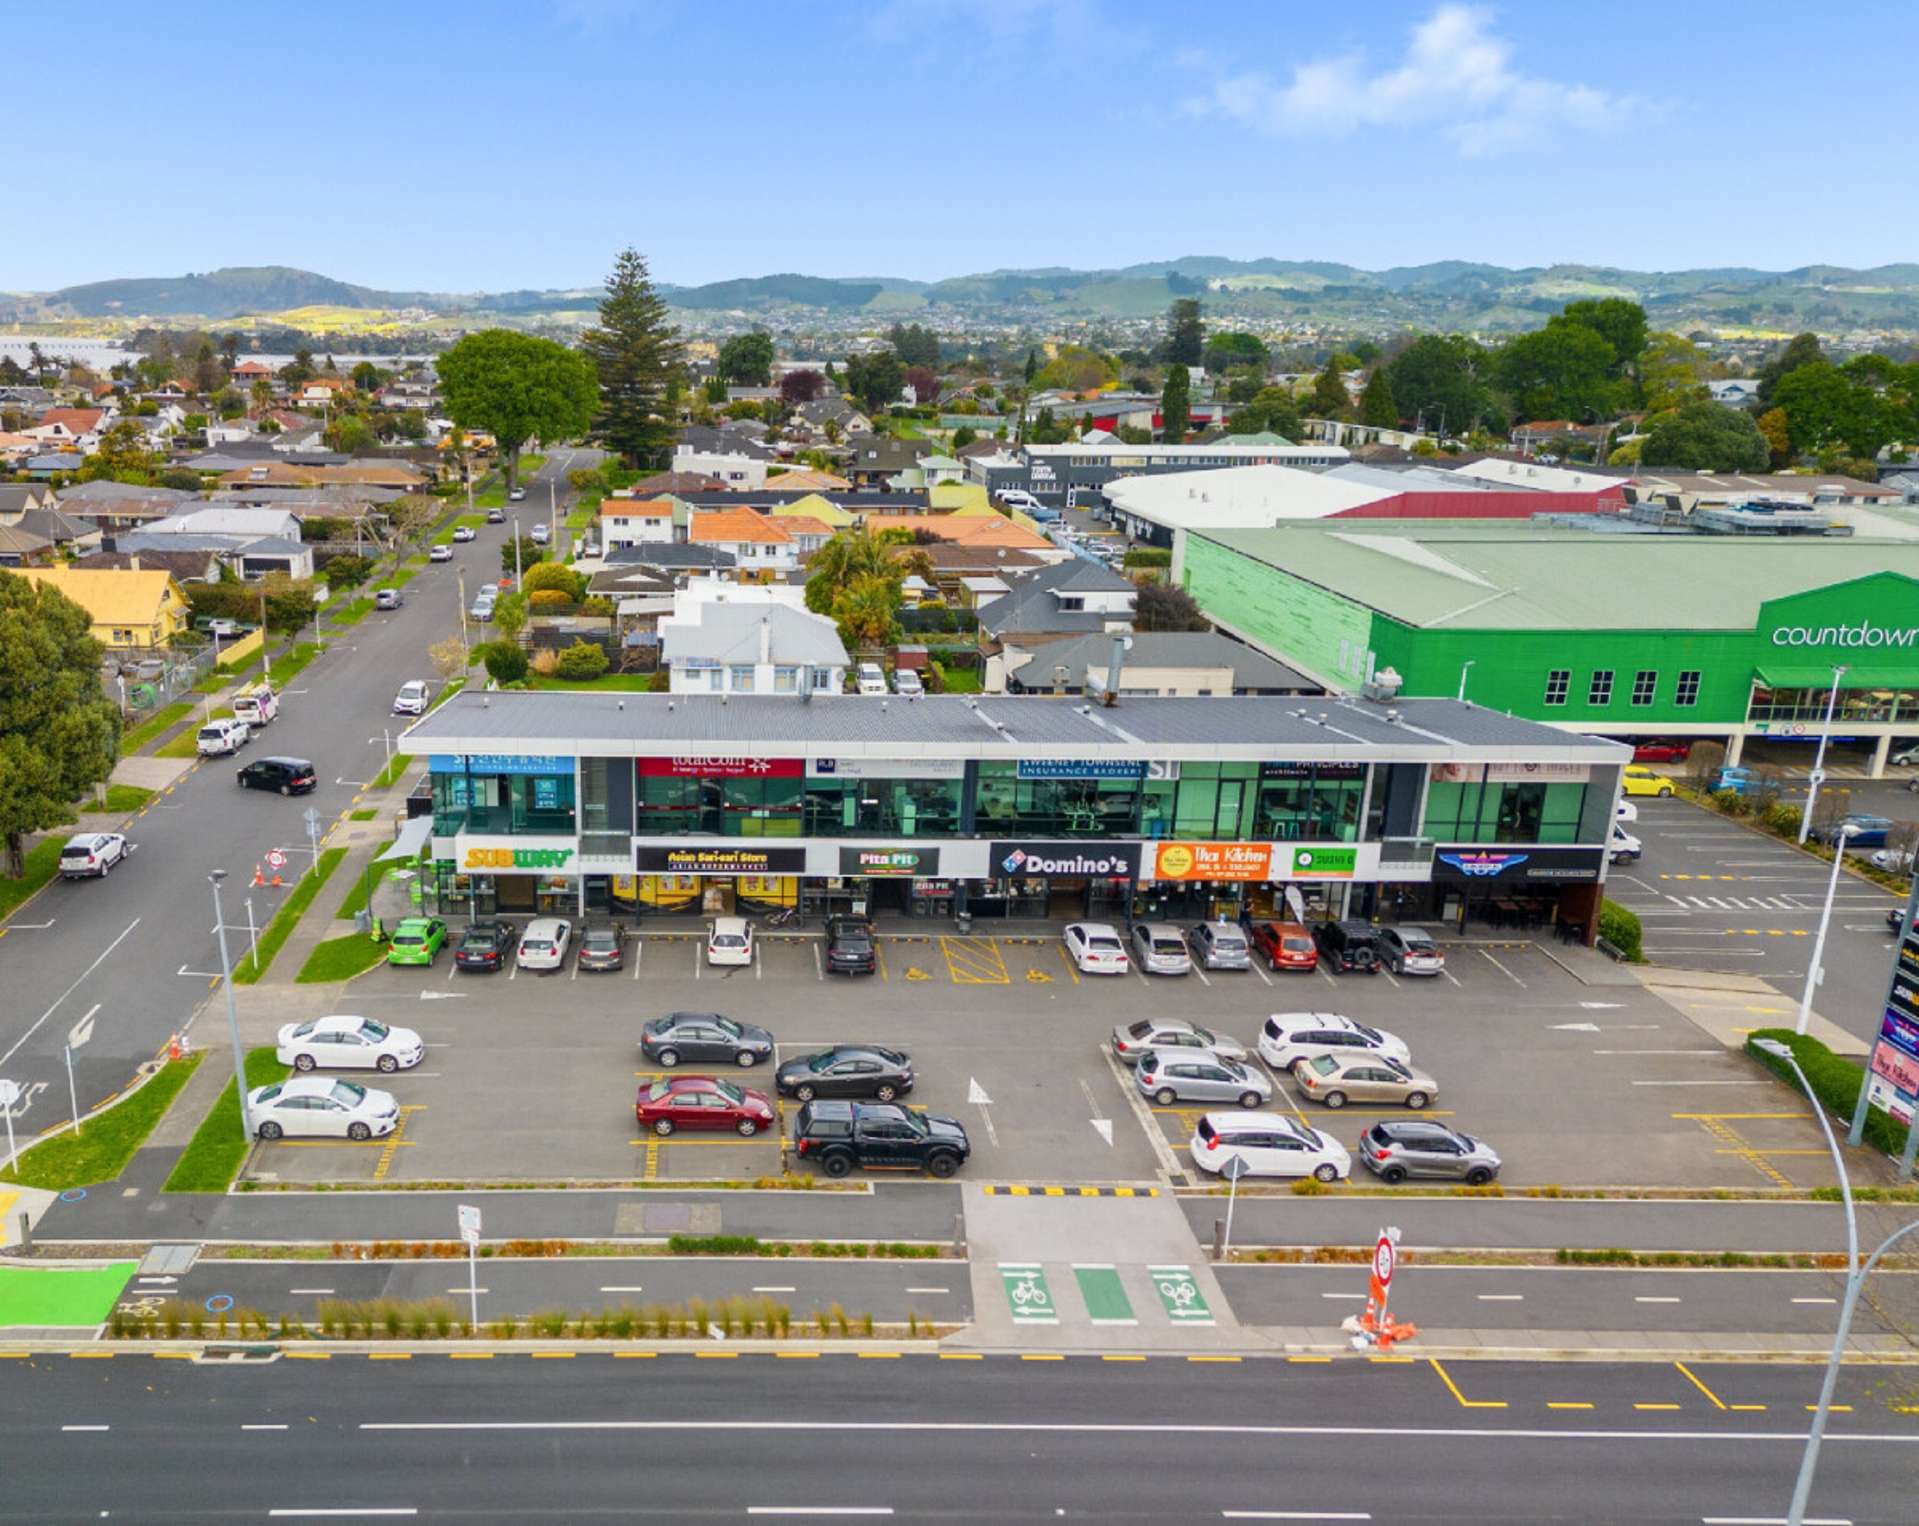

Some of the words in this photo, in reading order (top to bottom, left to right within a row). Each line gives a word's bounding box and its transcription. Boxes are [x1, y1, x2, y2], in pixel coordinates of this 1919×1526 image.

[464, 847, 574, 868] SUBWAY
[668, 851, 696, 862] Asian
[740, 851, 767, 862] Store
[860, 853, 888, 865] Pita
[1027, 856, 1128, 875] Domino's
